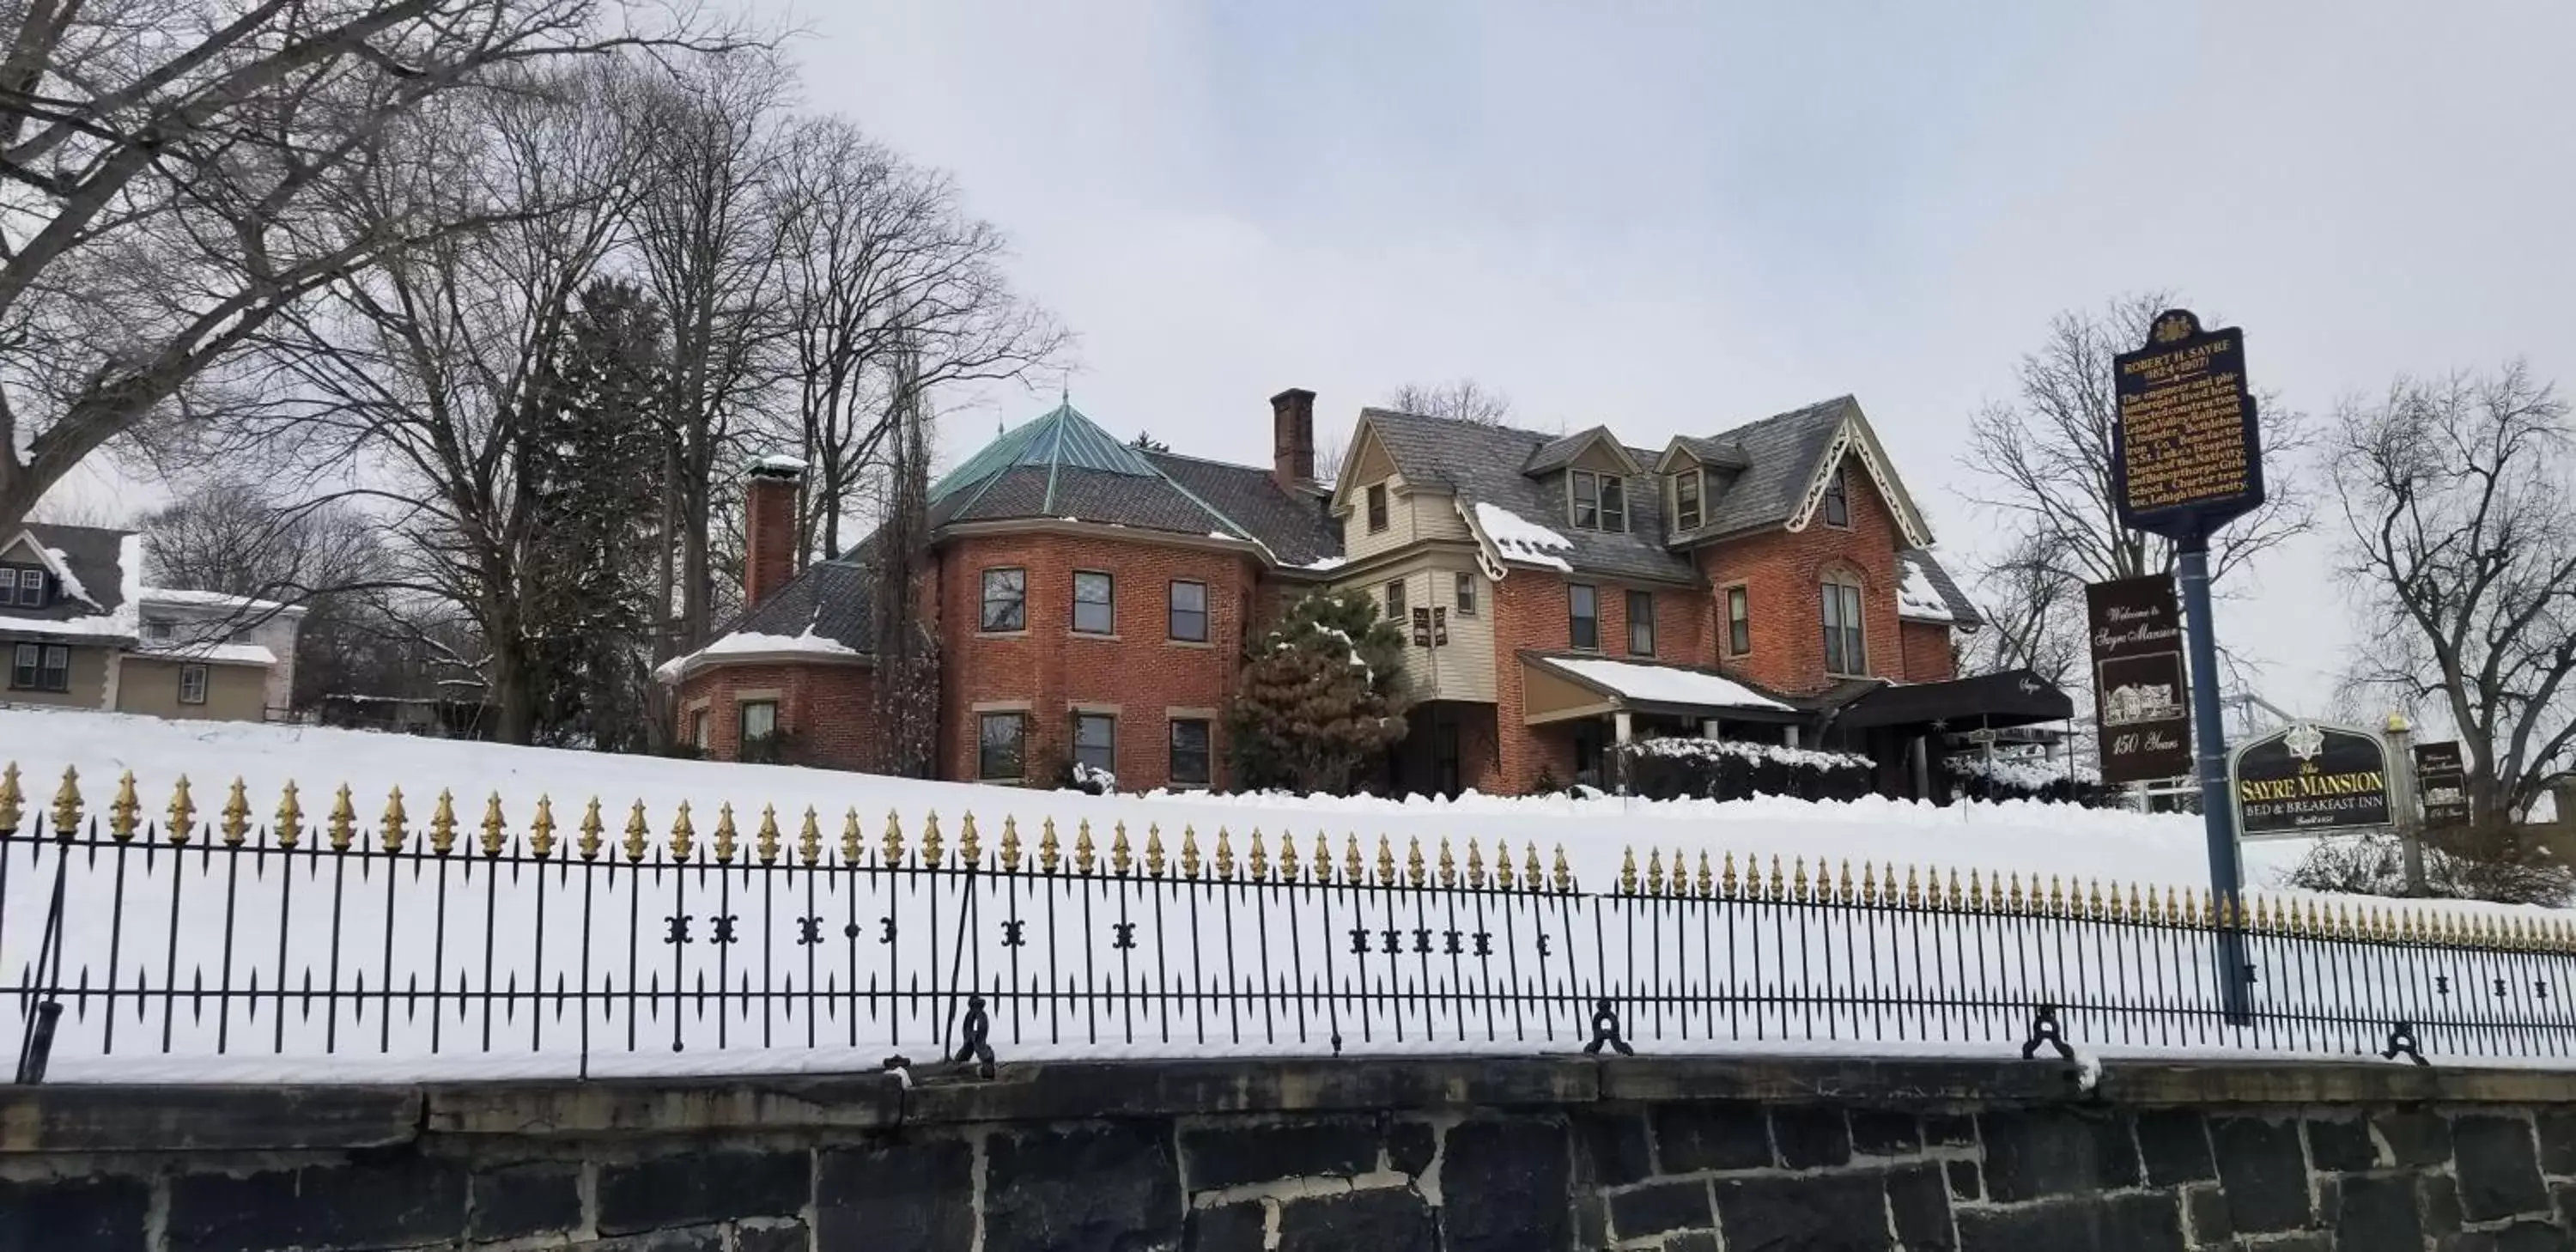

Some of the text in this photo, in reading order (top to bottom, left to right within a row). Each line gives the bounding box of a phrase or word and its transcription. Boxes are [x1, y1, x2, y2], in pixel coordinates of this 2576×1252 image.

[2123, 354, 2169, 374] ROBERT
[2189, 339, 2230, 357] SAYRE
[2121, 392, 2140, 404] The
[2142, 384, 2189, 400] engineer
[2191, 376, 2212, 389] and
[2180, 387, 2208, 402] lived
[2123, 419, 2159, 436] Lehigh
[2124, 435, 2133, 446] A
[2183, 415, 2241, 433] Bethlehem
[2124, 442, 2148, 456] Iron
[2178, 426, 2243, 444] Benefactor
[2126, 456, 2137, 466] to
[2126, 462, 2161, 475] Church
[2176, 455, 2194, 466] the
[2127, 475, 2145, 487] and
[2218, 456, 2247, 469] Girls
[2171, 473, 2216, 488] Charter
[2150, 489, 2187, 507] Lehigh
[2113, 732, 2139, 755] 150
[2241, 771, 2384, 802] SAYRE MANSION
[2246, 795, 2384, 817] BED & BREAKFAST INN
